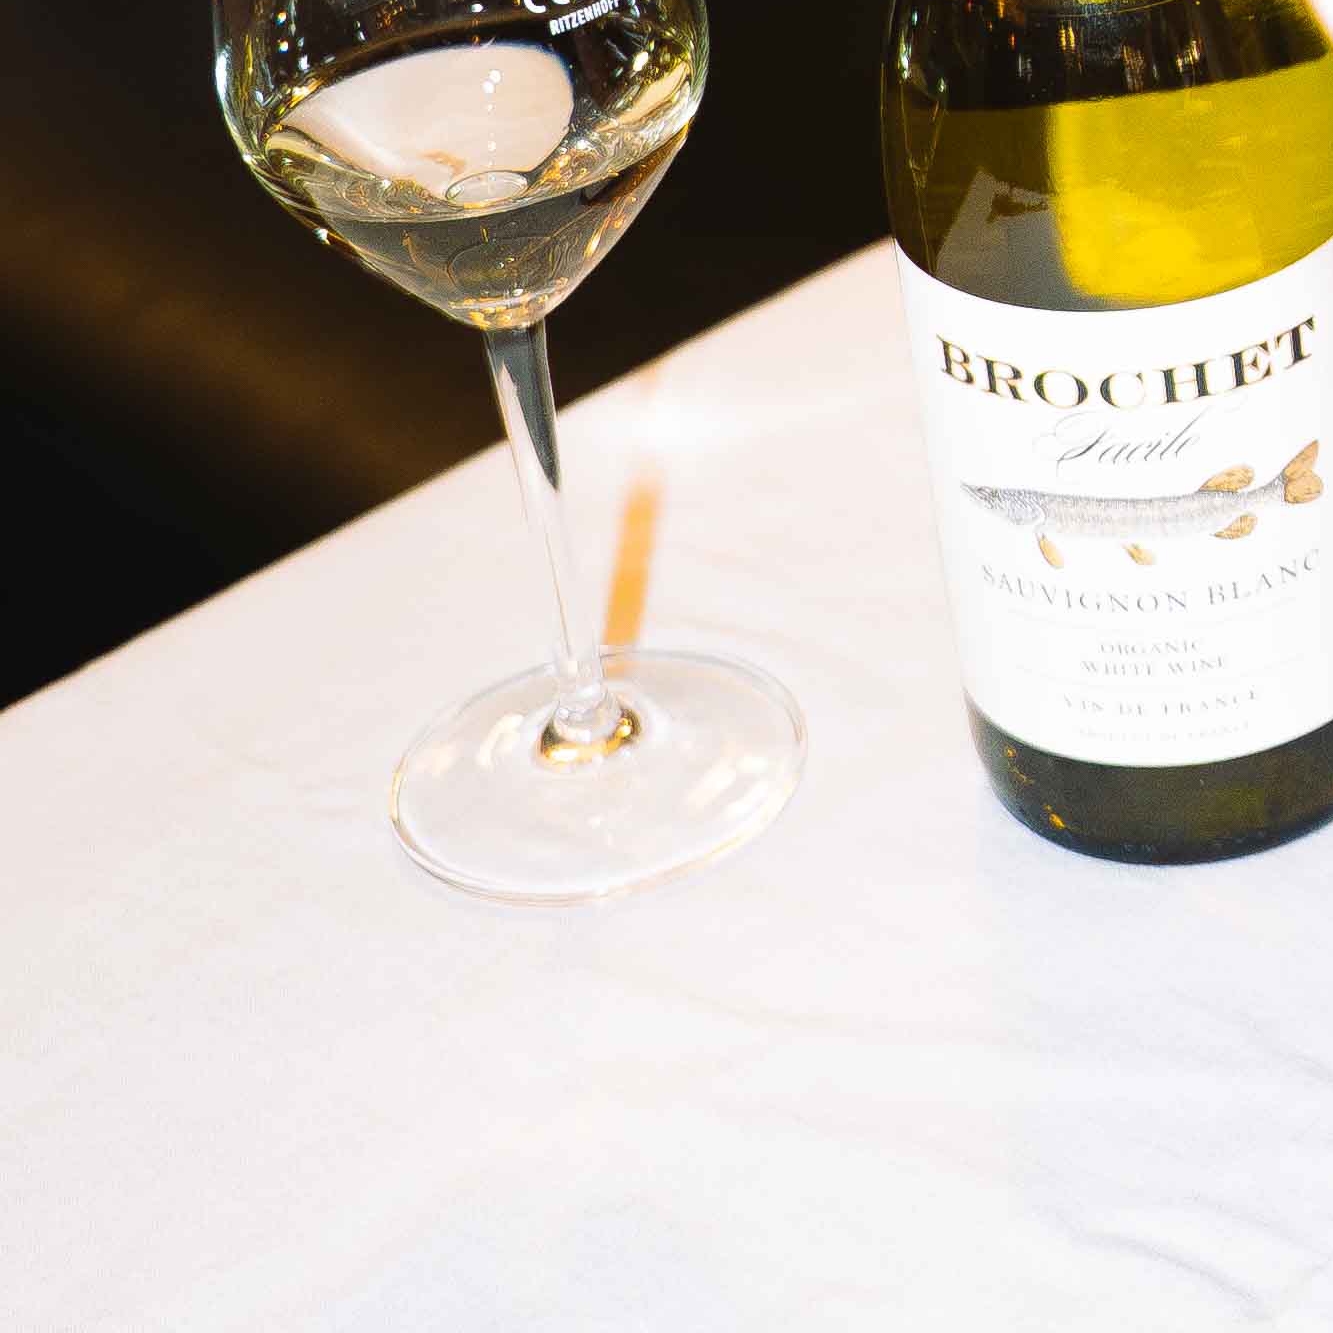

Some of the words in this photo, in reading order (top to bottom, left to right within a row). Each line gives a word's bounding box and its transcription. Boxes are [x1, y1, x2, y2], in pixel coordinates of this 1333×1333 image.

[936, 314, 1316, 410] BROCHET
[980, 563, 1191, 615] SAUVIGNON
[1207, 547, 1320, 606] BLANC
[1097, 638, 1204, 656] ORGANIC
[1081, 660, 1156, 678] WHITE
[1167, 654, 1228, 677] WINE
[1062, 692, 1106, 715] VIN
[1118, 700, 1147, 717] DE
[1160, 683, 1260, 717] FRANCE
